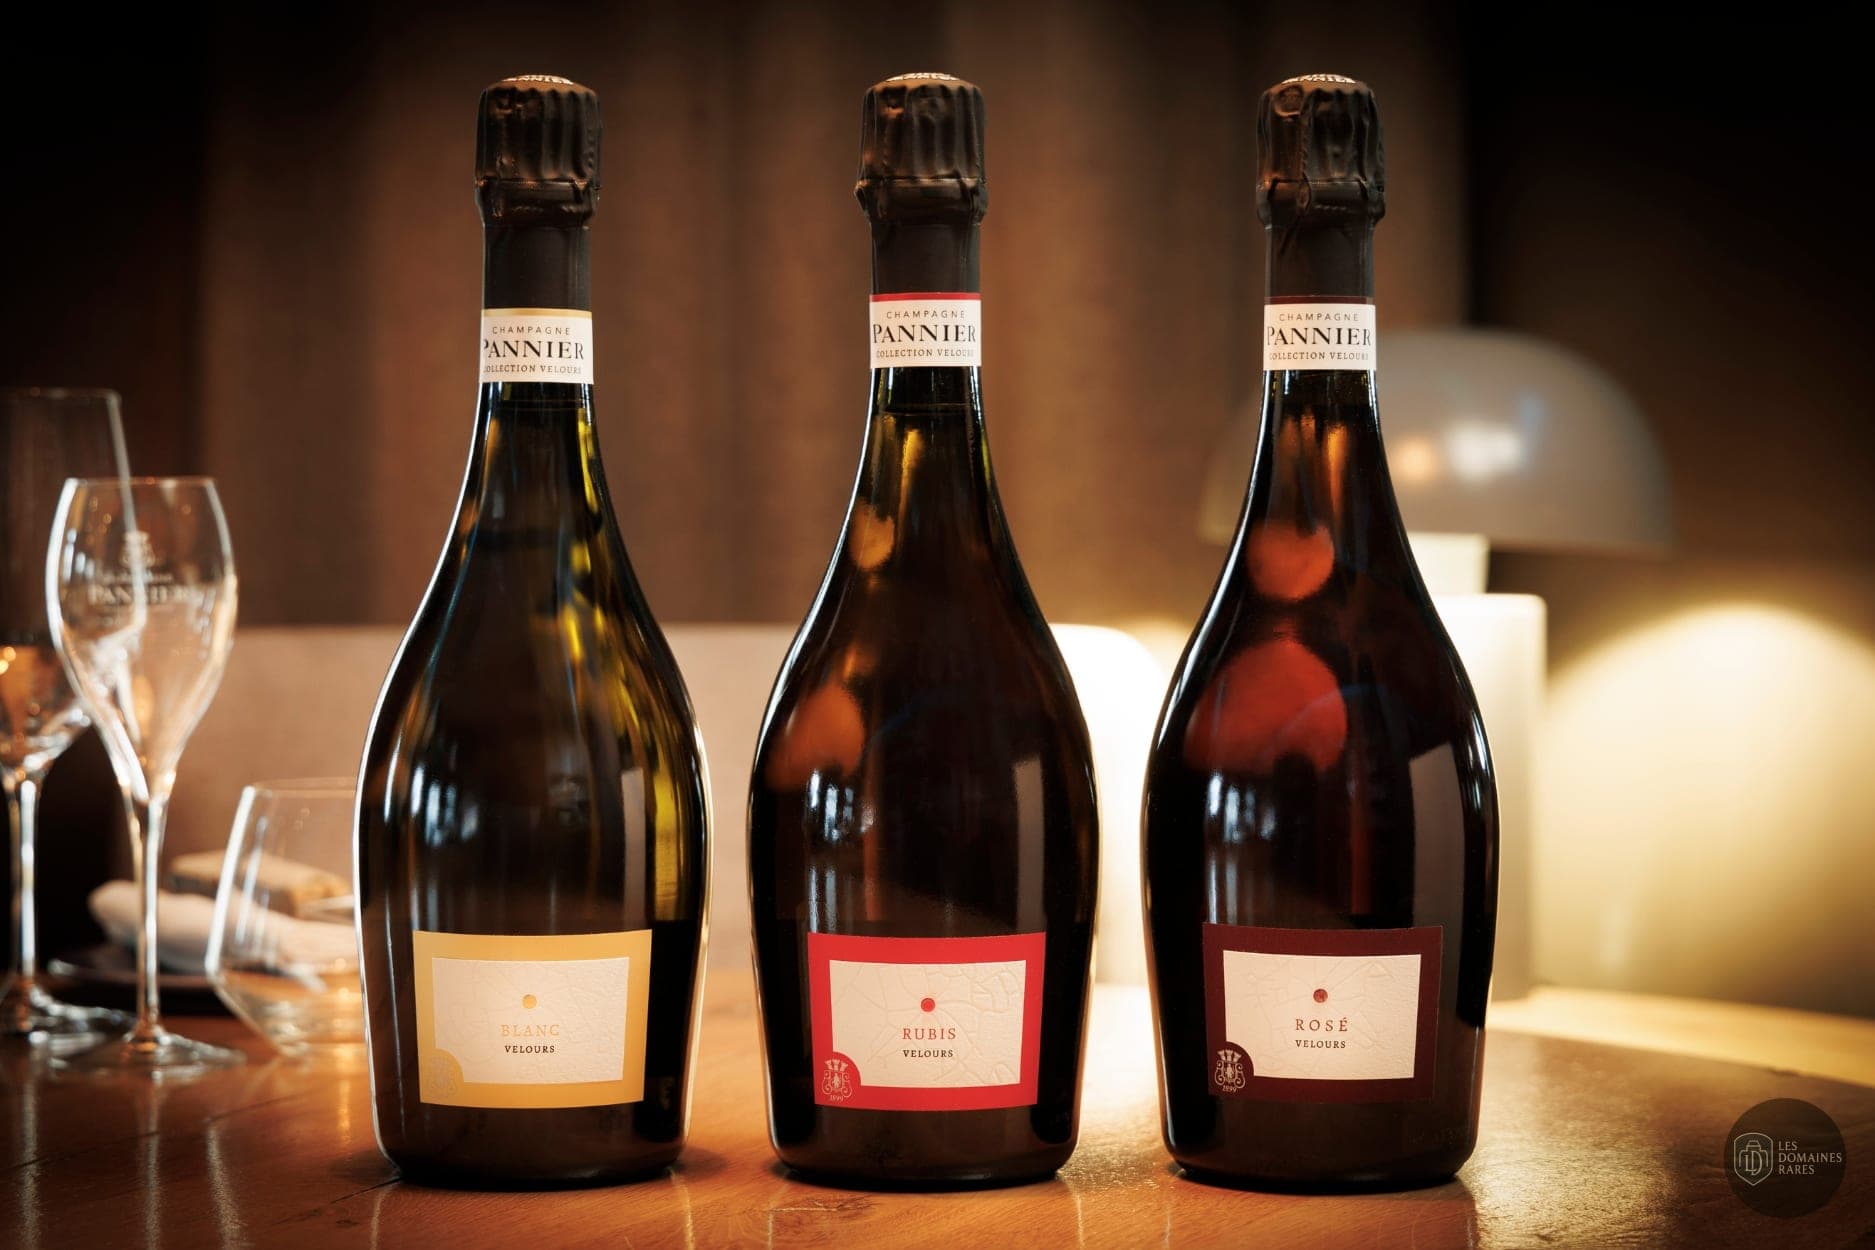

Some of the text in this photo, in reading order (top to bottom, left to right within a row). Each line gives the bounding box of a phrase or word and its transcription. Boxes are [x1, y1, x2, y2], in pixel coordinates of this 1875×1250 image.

[886, 310, 965, 319] CHAMPAGNE
[1279, 313, 1359, 321] CHAMPAGNE
[492, 326, 571, 335] CHAMPAGNE
[872, 323, 976, 343] PANNIER
[1267, 326, 1371, 346] PANNIER
[1295, 1017, 1348, 1032] ROSÉ
[501, 1024, 560, 1037] BLANC
[902, 1027, 957, 1040] RUBIS
[1295, 1039, 1346, 1049] VELOURS
[504, 1045, 556, 1054] VELOURS
[903, 1049, 954, 1058] VELOURS
